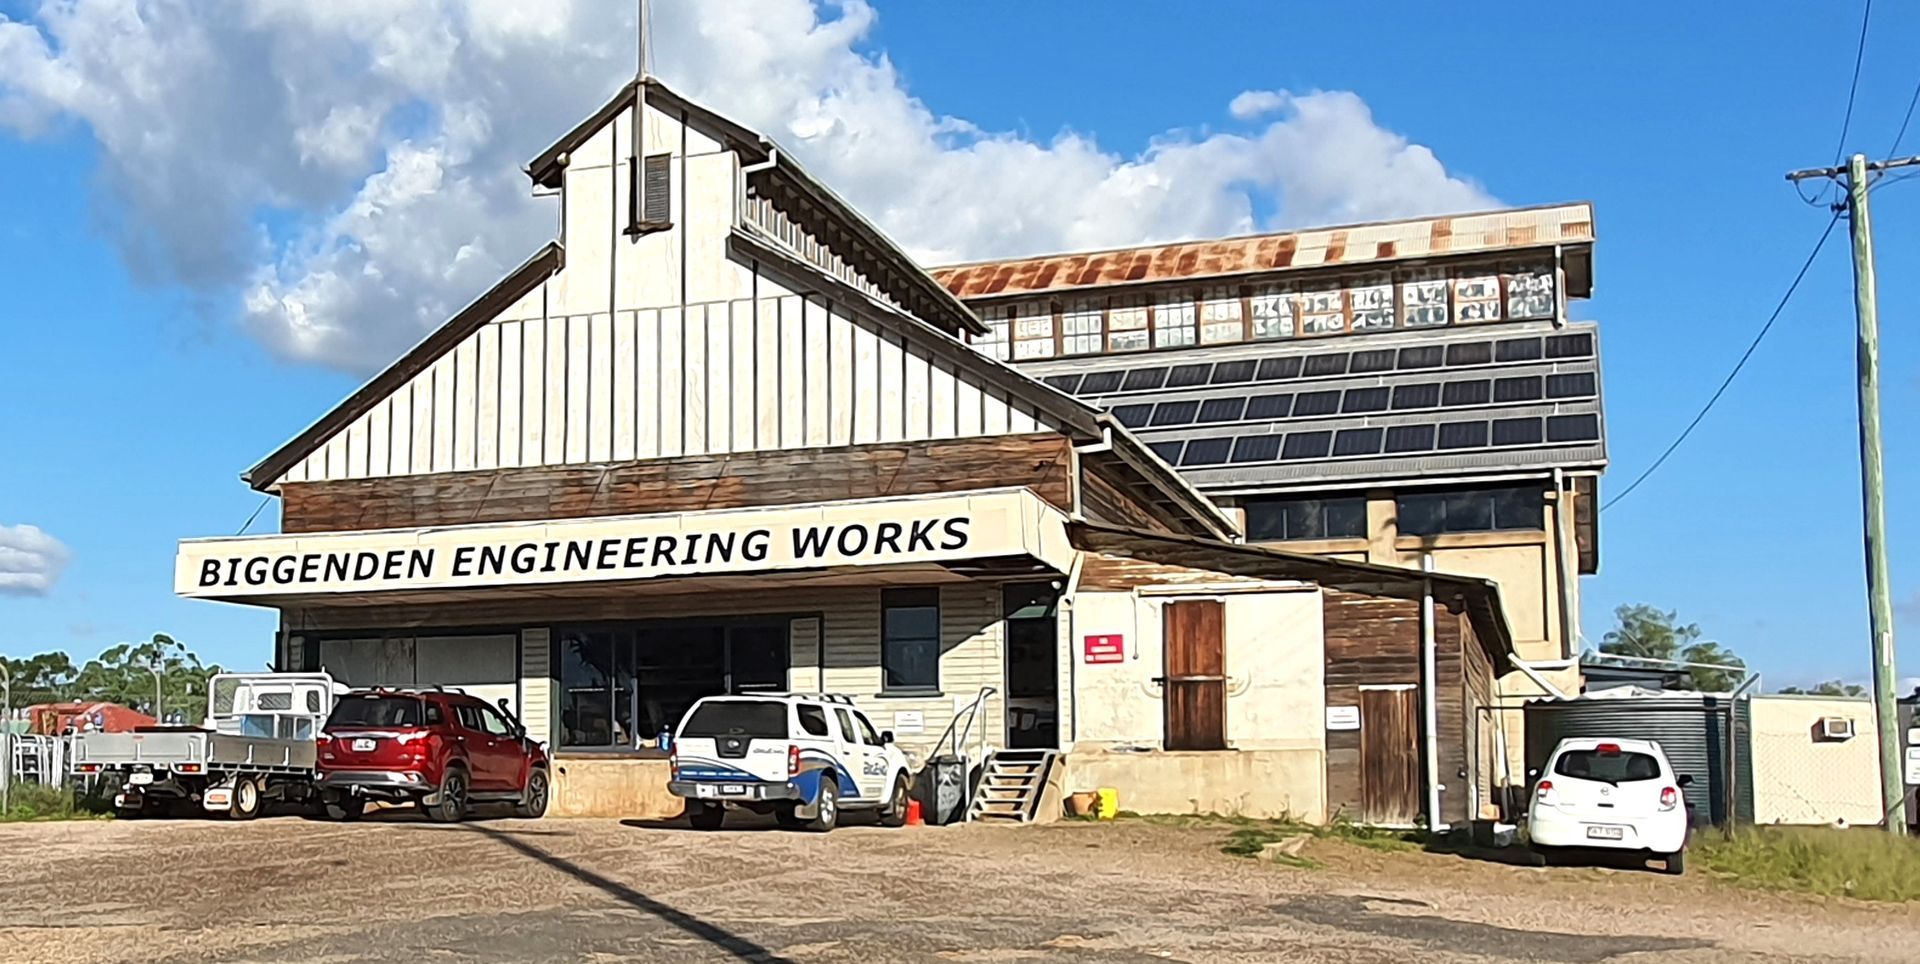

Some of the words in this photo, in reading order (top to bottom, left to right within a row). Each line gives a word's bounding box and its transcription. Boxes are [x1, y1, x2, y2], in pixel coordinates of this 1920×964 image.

[198, 547, 435, 588] BIGGENDEN
[451, 528, 769, 576] ENGINEERING
[791, 516, 970, 559] WORKS
